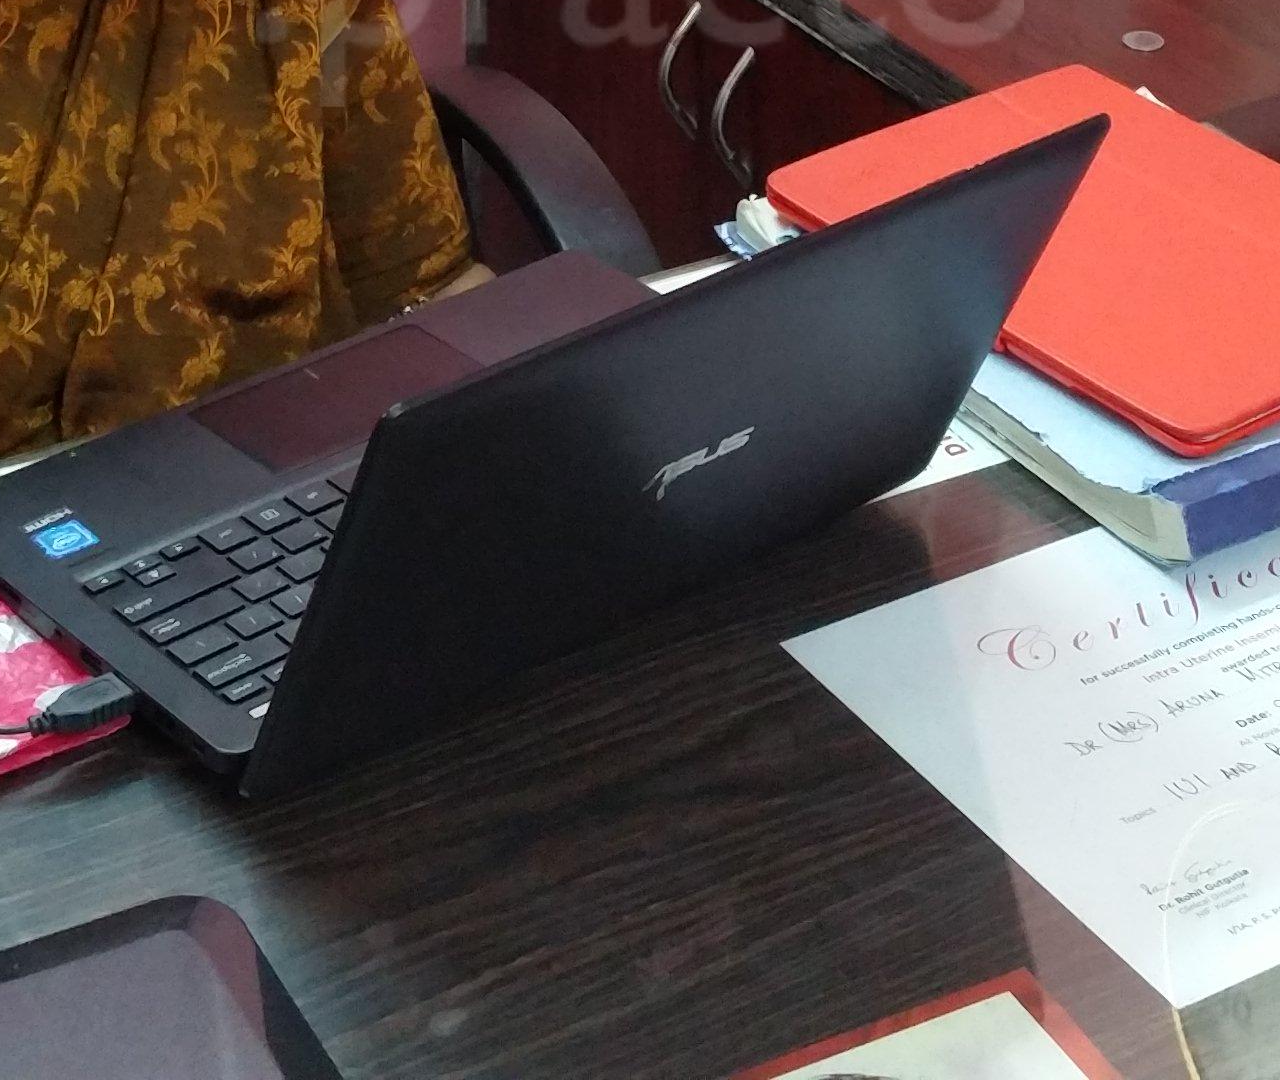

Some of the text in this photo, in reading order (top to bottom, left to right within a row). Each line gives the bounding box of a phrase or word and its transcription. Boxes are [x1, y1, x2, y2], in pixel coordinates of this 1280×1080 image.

[642, 426, 755, 501] ASUS
[1080, 675, 1099, 687] for
[1101, 646, 1171, 679] successfully
[1172, 620, 1238, 651] completing
[1142, 665, 1179, 684] Intra
[1180, 642, 1235, 670] Uterine
[1220, 646, 1271, 673] awarded
[1235, 711, 1272, 728] Date:
[1220, 761, 1258, 781] AND
[1174, 889, 1205, 905] Rohit
